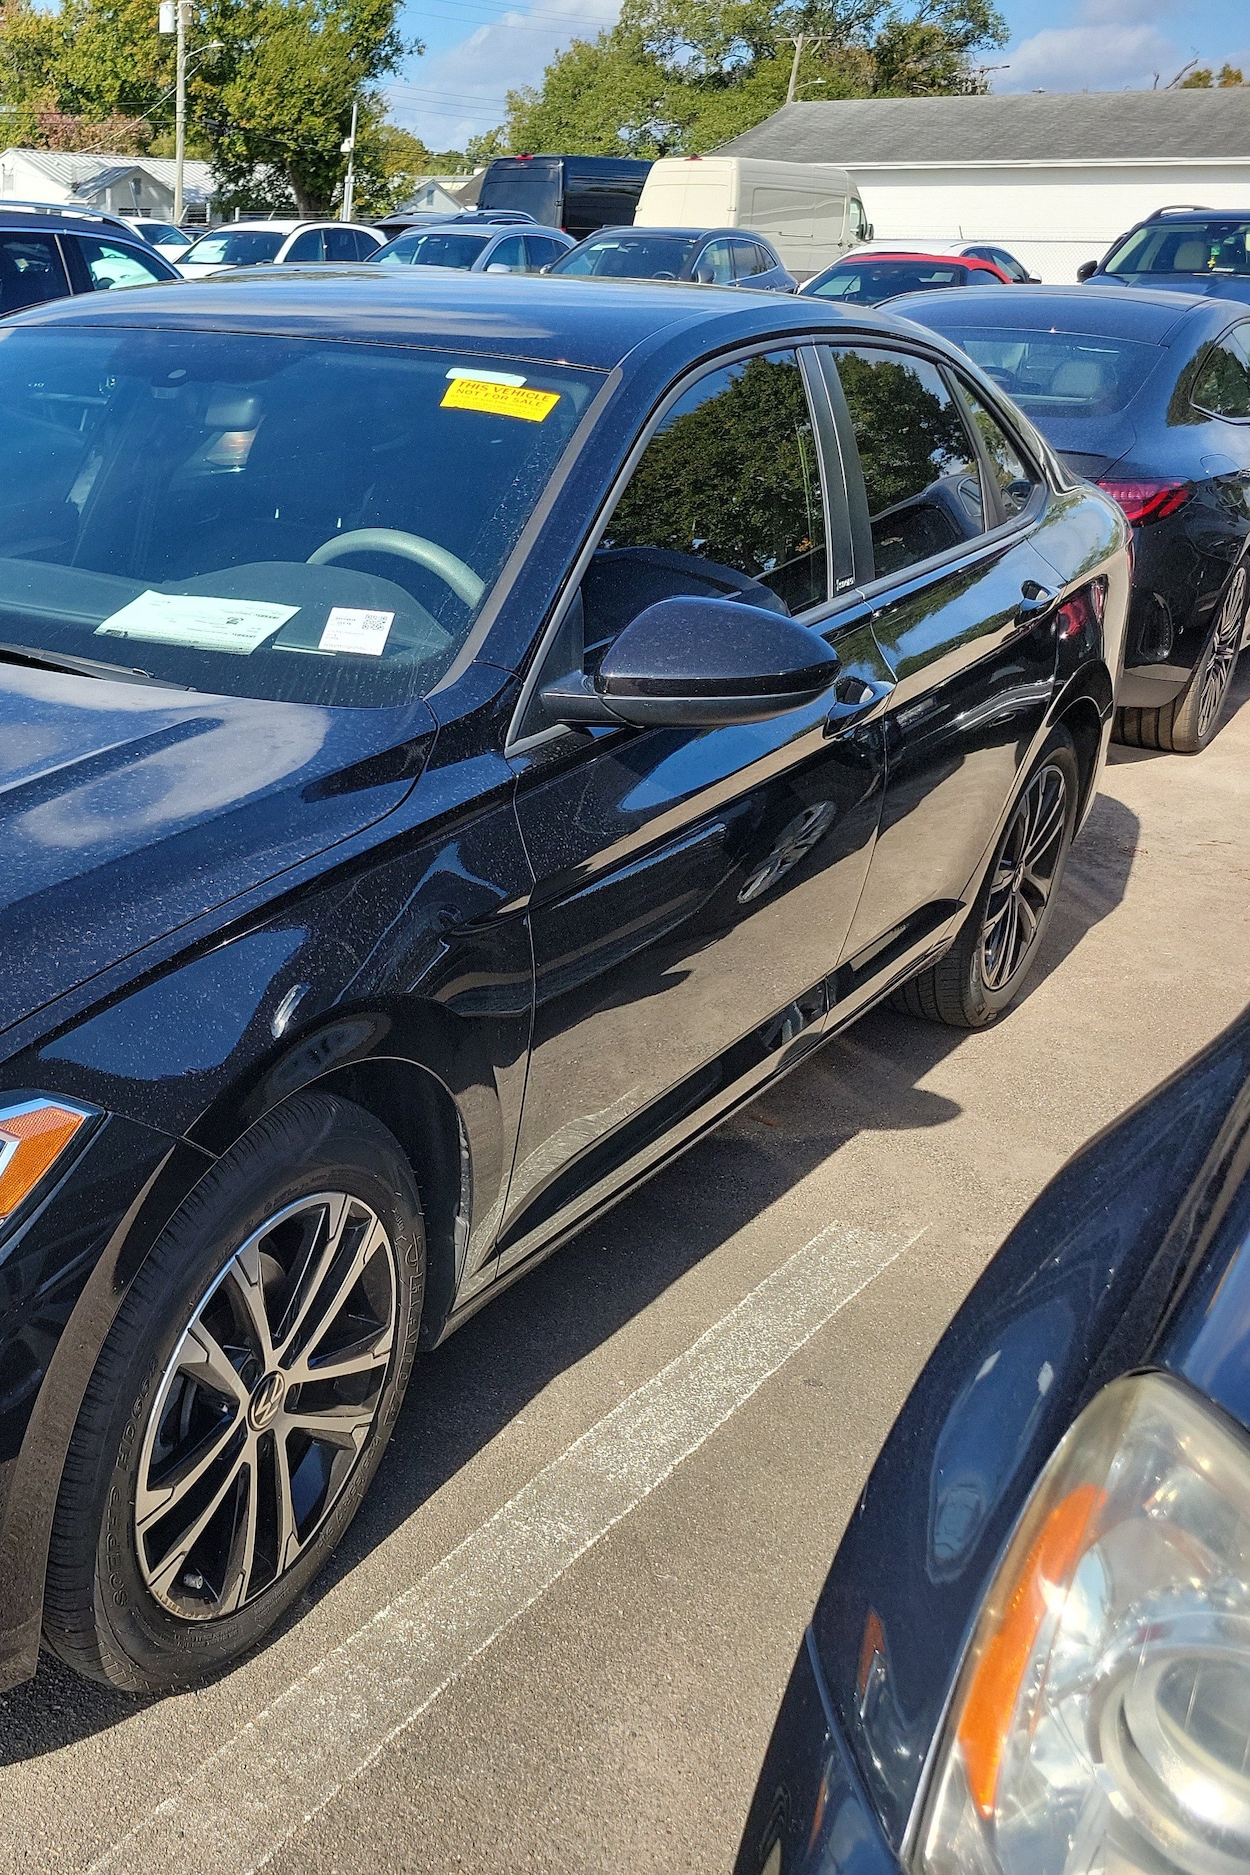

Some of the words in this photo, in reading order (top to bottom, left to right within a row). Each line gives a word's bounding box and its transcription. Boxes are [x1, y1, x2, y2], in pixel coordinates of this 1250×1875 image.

[456, 388, 481, 396] NOT
[484, 392, 509, 401] FOR
[513, 397, 544, 407] SALE
[458, 381, 488, 391] THIS
[494, 386, 551, 402] VEHICLE
